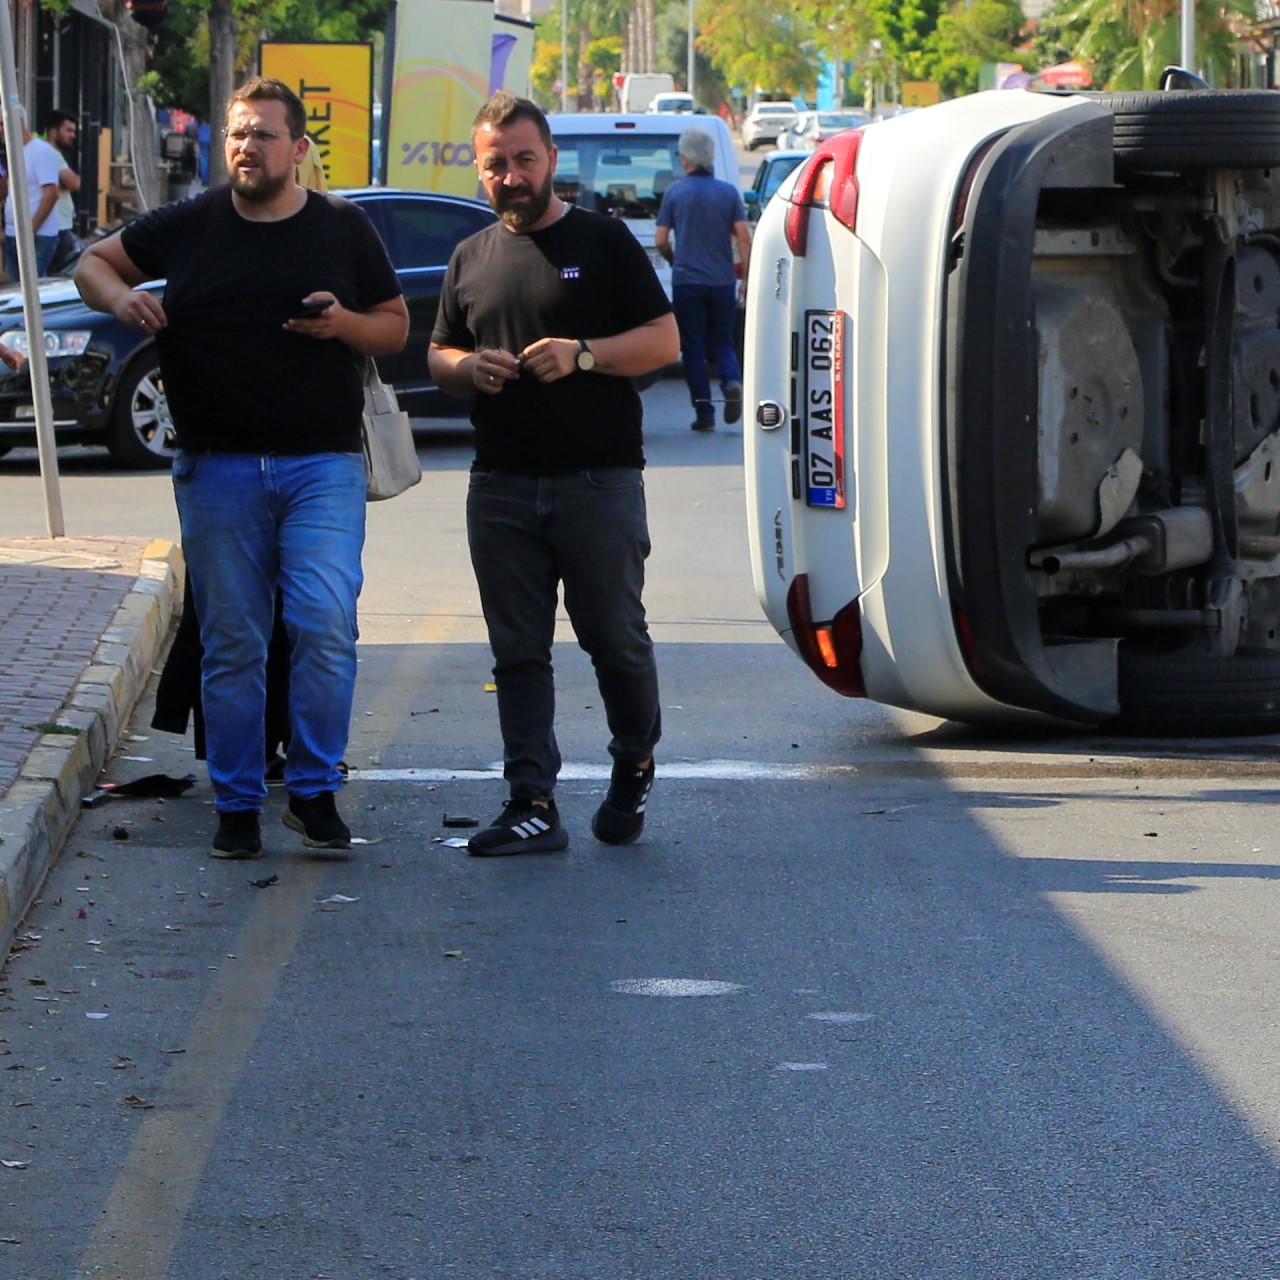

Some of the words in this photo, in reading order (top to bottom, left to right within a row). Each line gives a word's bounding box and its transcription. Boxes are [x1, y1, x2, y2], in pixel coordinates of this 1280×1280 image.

[811, 319, 834, 371] 062
[834, 315, 842, 358] KAPLAN
[810, 389, 833, 441] AAS
[811, 452, 834, 487] 07
